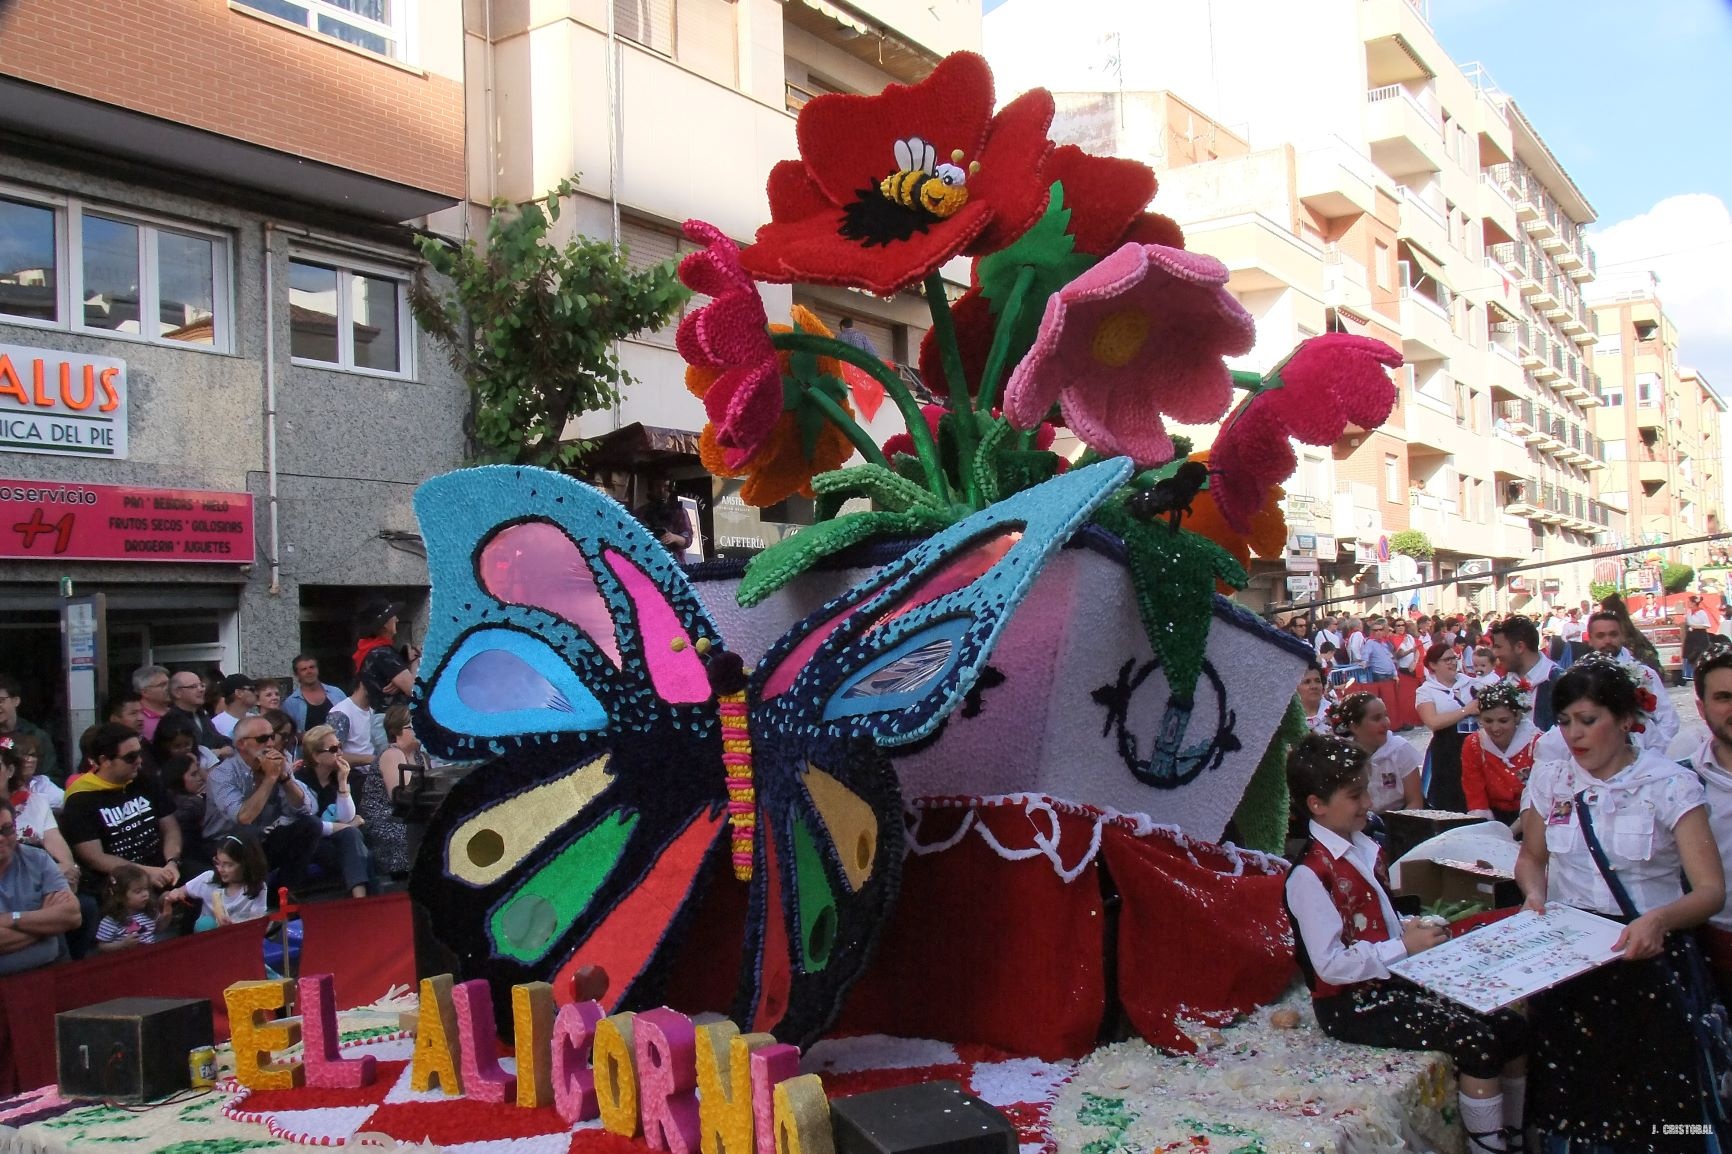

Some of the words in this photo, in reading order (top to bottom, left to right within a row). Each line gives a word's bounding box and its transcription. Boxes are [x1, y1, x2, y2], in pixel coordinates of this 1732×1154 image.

[0, 420, 42, 440] ICA
[51, 424, 82, 443] DEL
[91, 427, 113, 446] PIE
[0, 486, 97, 505] oservicio
[109, 517, 147, 531] FRUTOS
[152, 519, 183, 532] SECOS
[192, 520, 243, 534] GOLOSINAS
[184, 541, 231, 554] JUGUETES
[720, 536, 765, 548] CAFETERÍA
[224, 973, 377, 1090] EL
